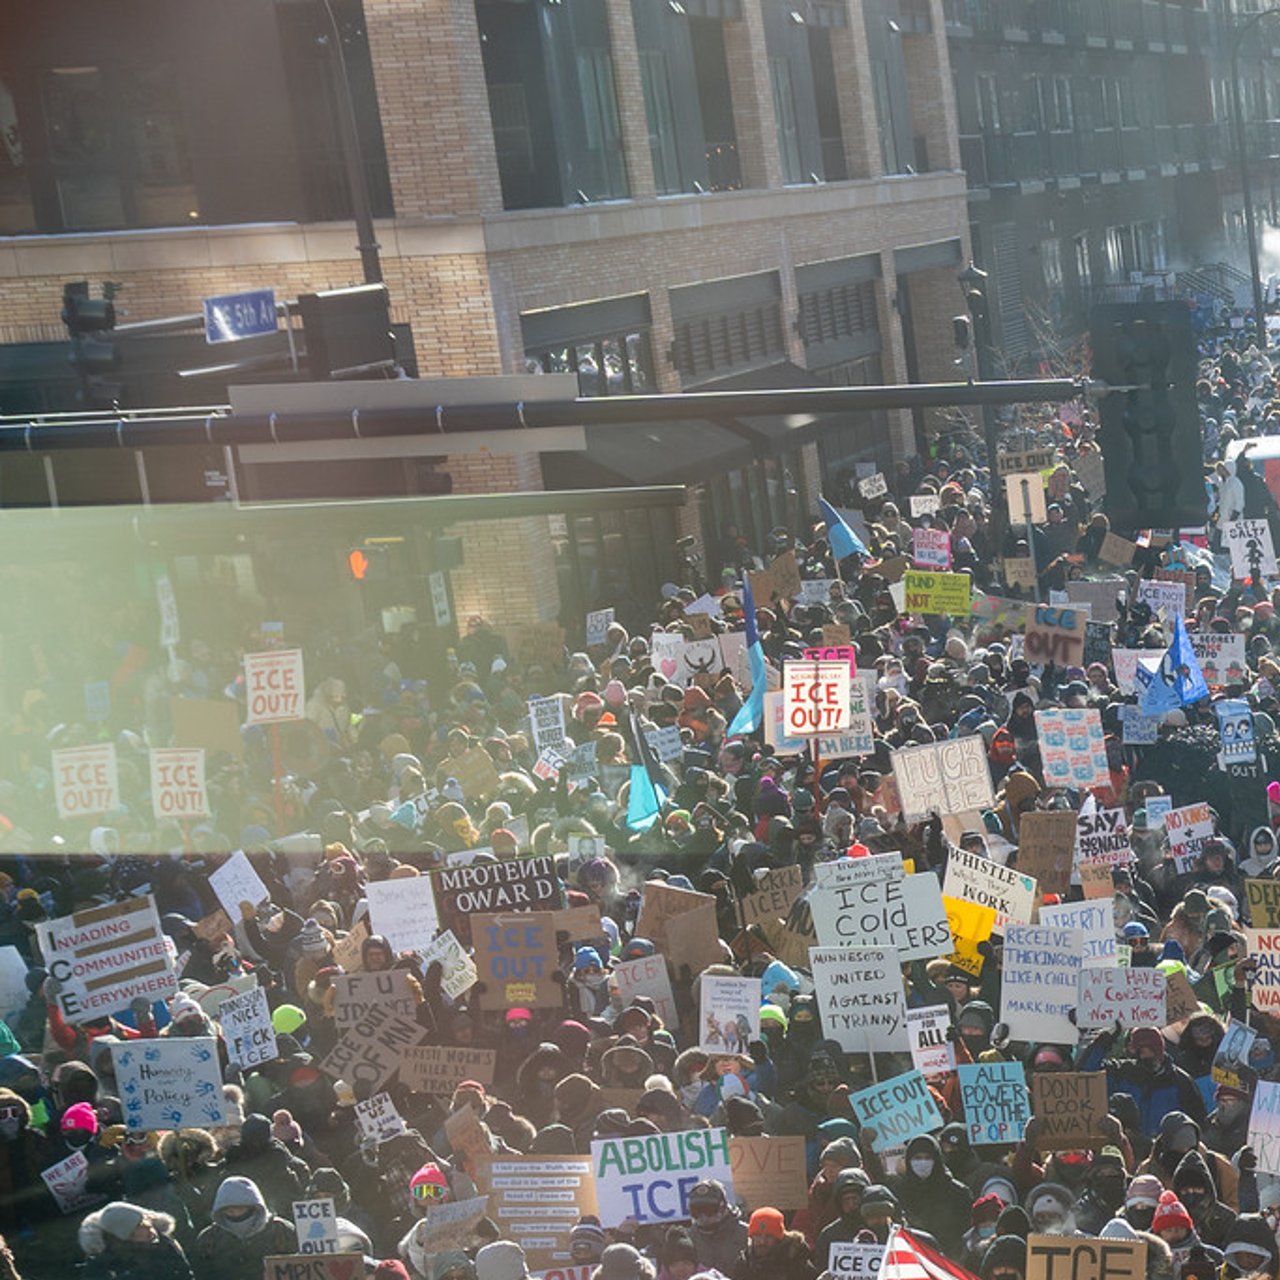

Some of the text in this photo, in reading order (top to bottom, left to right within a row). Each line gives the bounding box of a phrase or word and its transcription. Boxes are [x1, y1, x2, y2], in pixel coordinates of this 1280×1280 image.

[252, 670, 295, 691] ICE
[252, 692, 299, 714] OUT!
[791, 683, 838, 706] ICE
[791, 706, 841, 728] OUT!
[49, 917, 131, 953] INVADING
[52, 940, 174, 982] COMMUNITIES
[62, 974, 176, 1017] EVERYWHERE
[1042, 1097, 1092, 1118] LOOK
[1040, 1116, 1095, 1138] AWAY
[597, 1127, 730, 1177] ABOLISH
